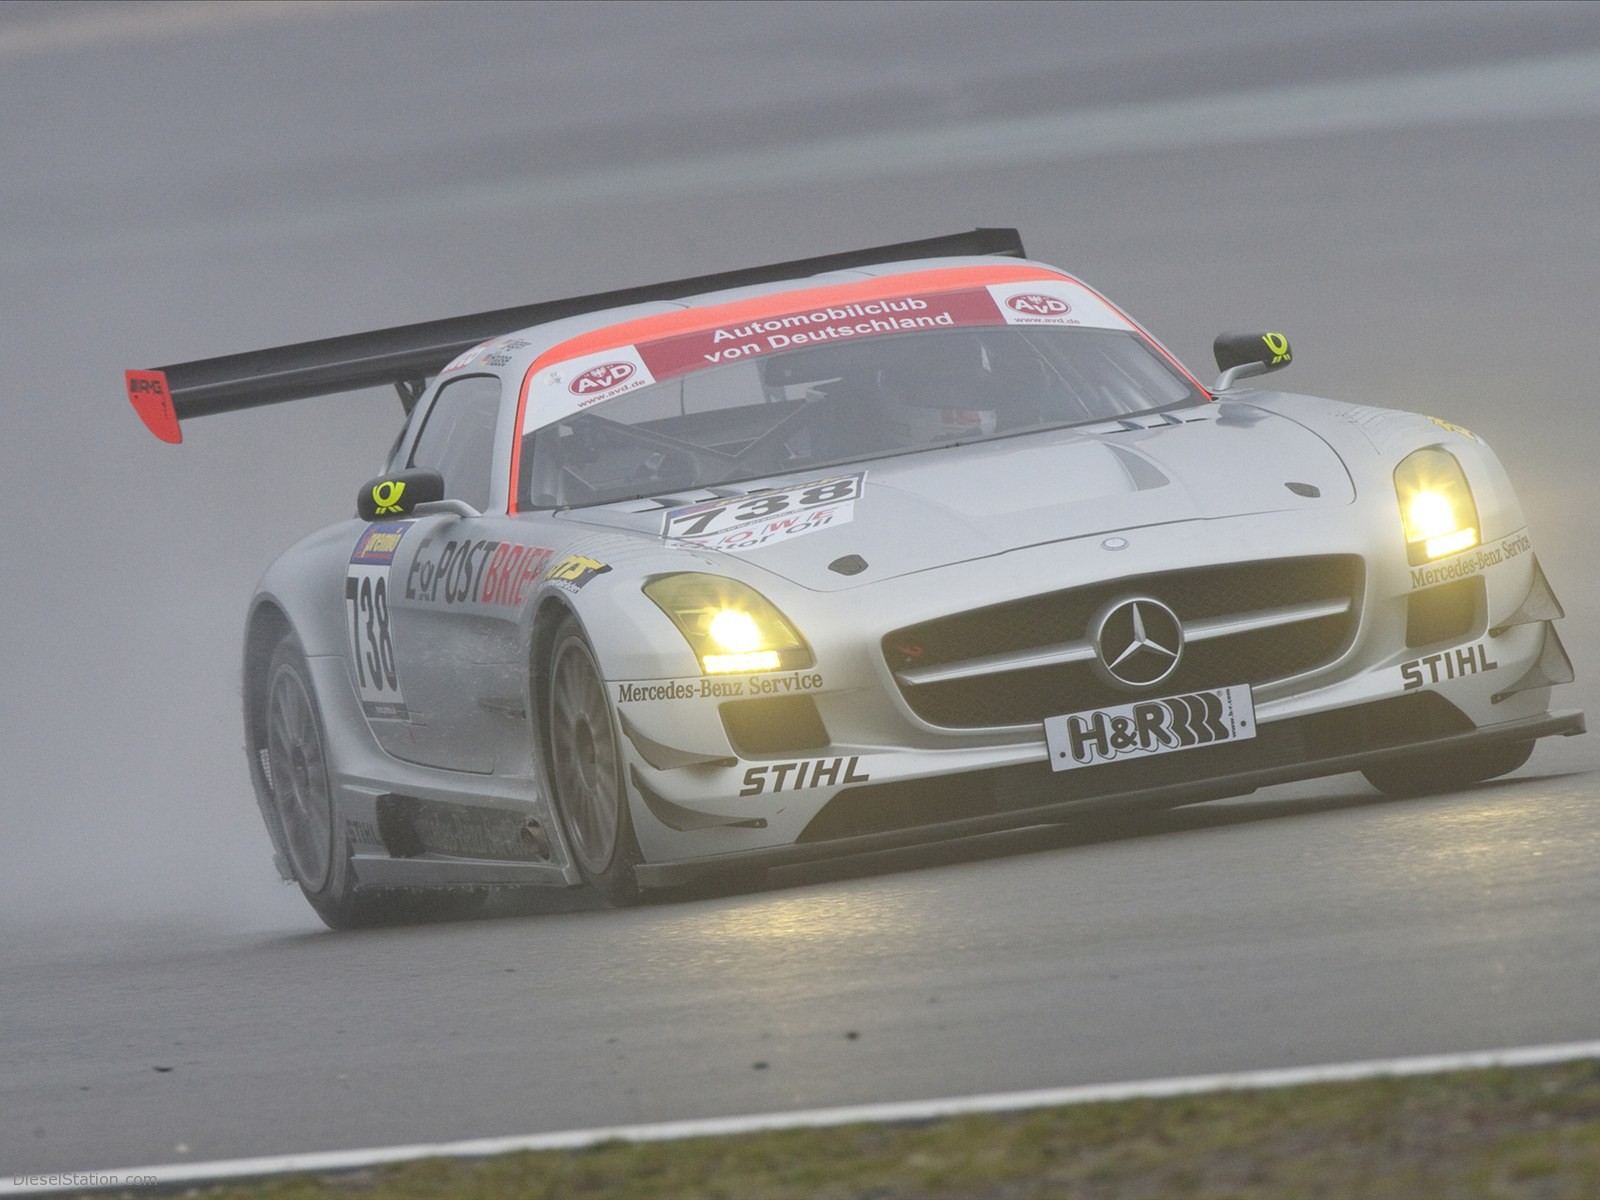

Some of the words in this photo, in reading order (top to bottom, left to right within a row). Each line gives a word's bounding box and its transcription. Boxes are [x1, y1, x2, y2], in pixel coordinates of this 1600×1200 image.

[703, 343, 761, 363] von
[766, 311, 955, 349] Deutschland
[713, 297, 928, 344] Automobilclub
[1014, 317, 1081, 326] www.avd.de
[577, 380, 646, 408] www.avd.de
[578, 364, 632, 393] AvD
[673, 479, 854, 536] 738
[1409, 548, 1504, 589] Mercedes-Benz
[1502, 534, 1532, 559] Service
[346, 576, 398, 692] 738
[618, 679, 744, 703] Mercedes-Benz
[749, 672, 823, 695] Service
[1400, 644, 1498, 690] STIHL
[1067, 701, 1181, 764] H&R
[739, 756, 870, 797] STIHL
